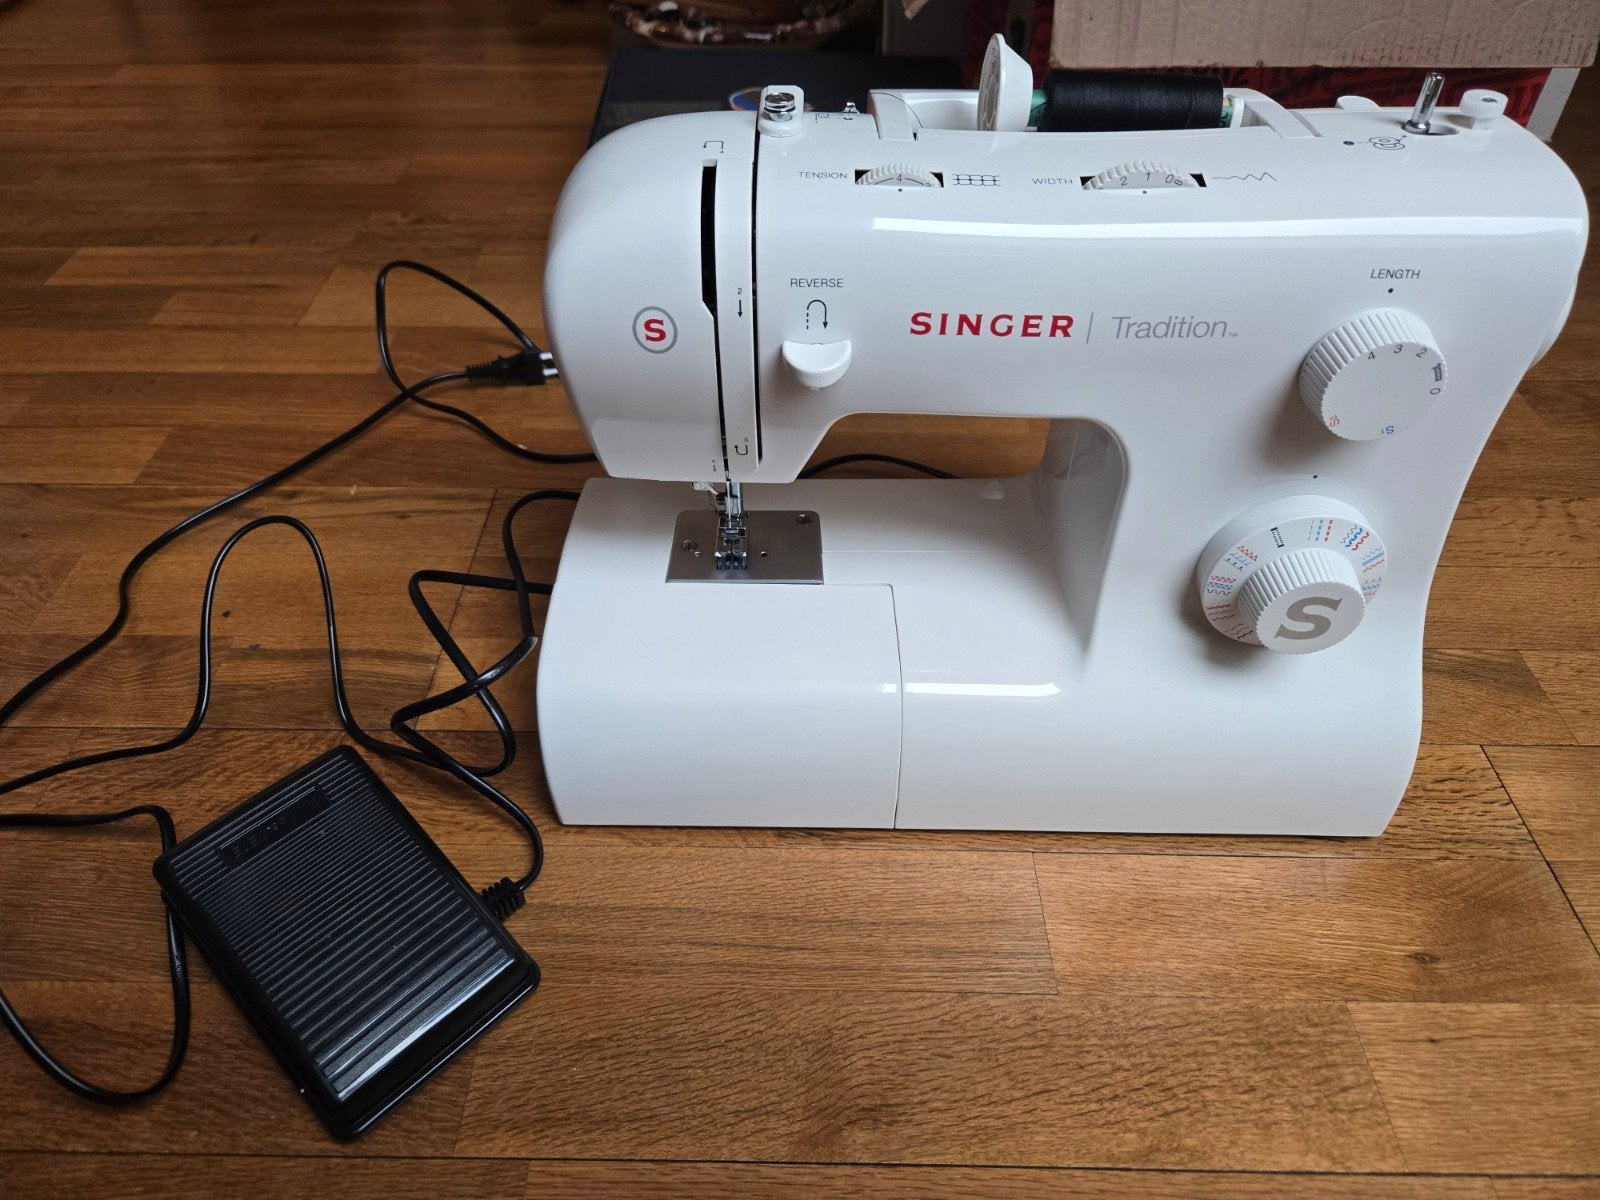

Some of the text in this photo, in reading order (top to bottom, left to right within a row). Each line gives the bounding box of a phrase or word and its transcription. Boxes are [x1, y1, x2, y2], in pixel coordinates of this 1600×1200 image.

[798, 171, 848, 179] TENSION
[896, 173, 903, 182] 4
[1031, 176, 1073, 185] WIDTH
[1120, 176, 1128, 186] 2
[1146, 171, 1151, 181] 1
[1370, 268, 1421, 280] LENGTH
[790, 278, 844, 288] REVERSE
[737, 287, 743, 295] 2
[643, 318, 667, 342] S
[909, 312, 1074, 338] SINGER
[1367, 344, 1441, 395] 4 3 2 0
[1274, 596, 1343, 641] S
